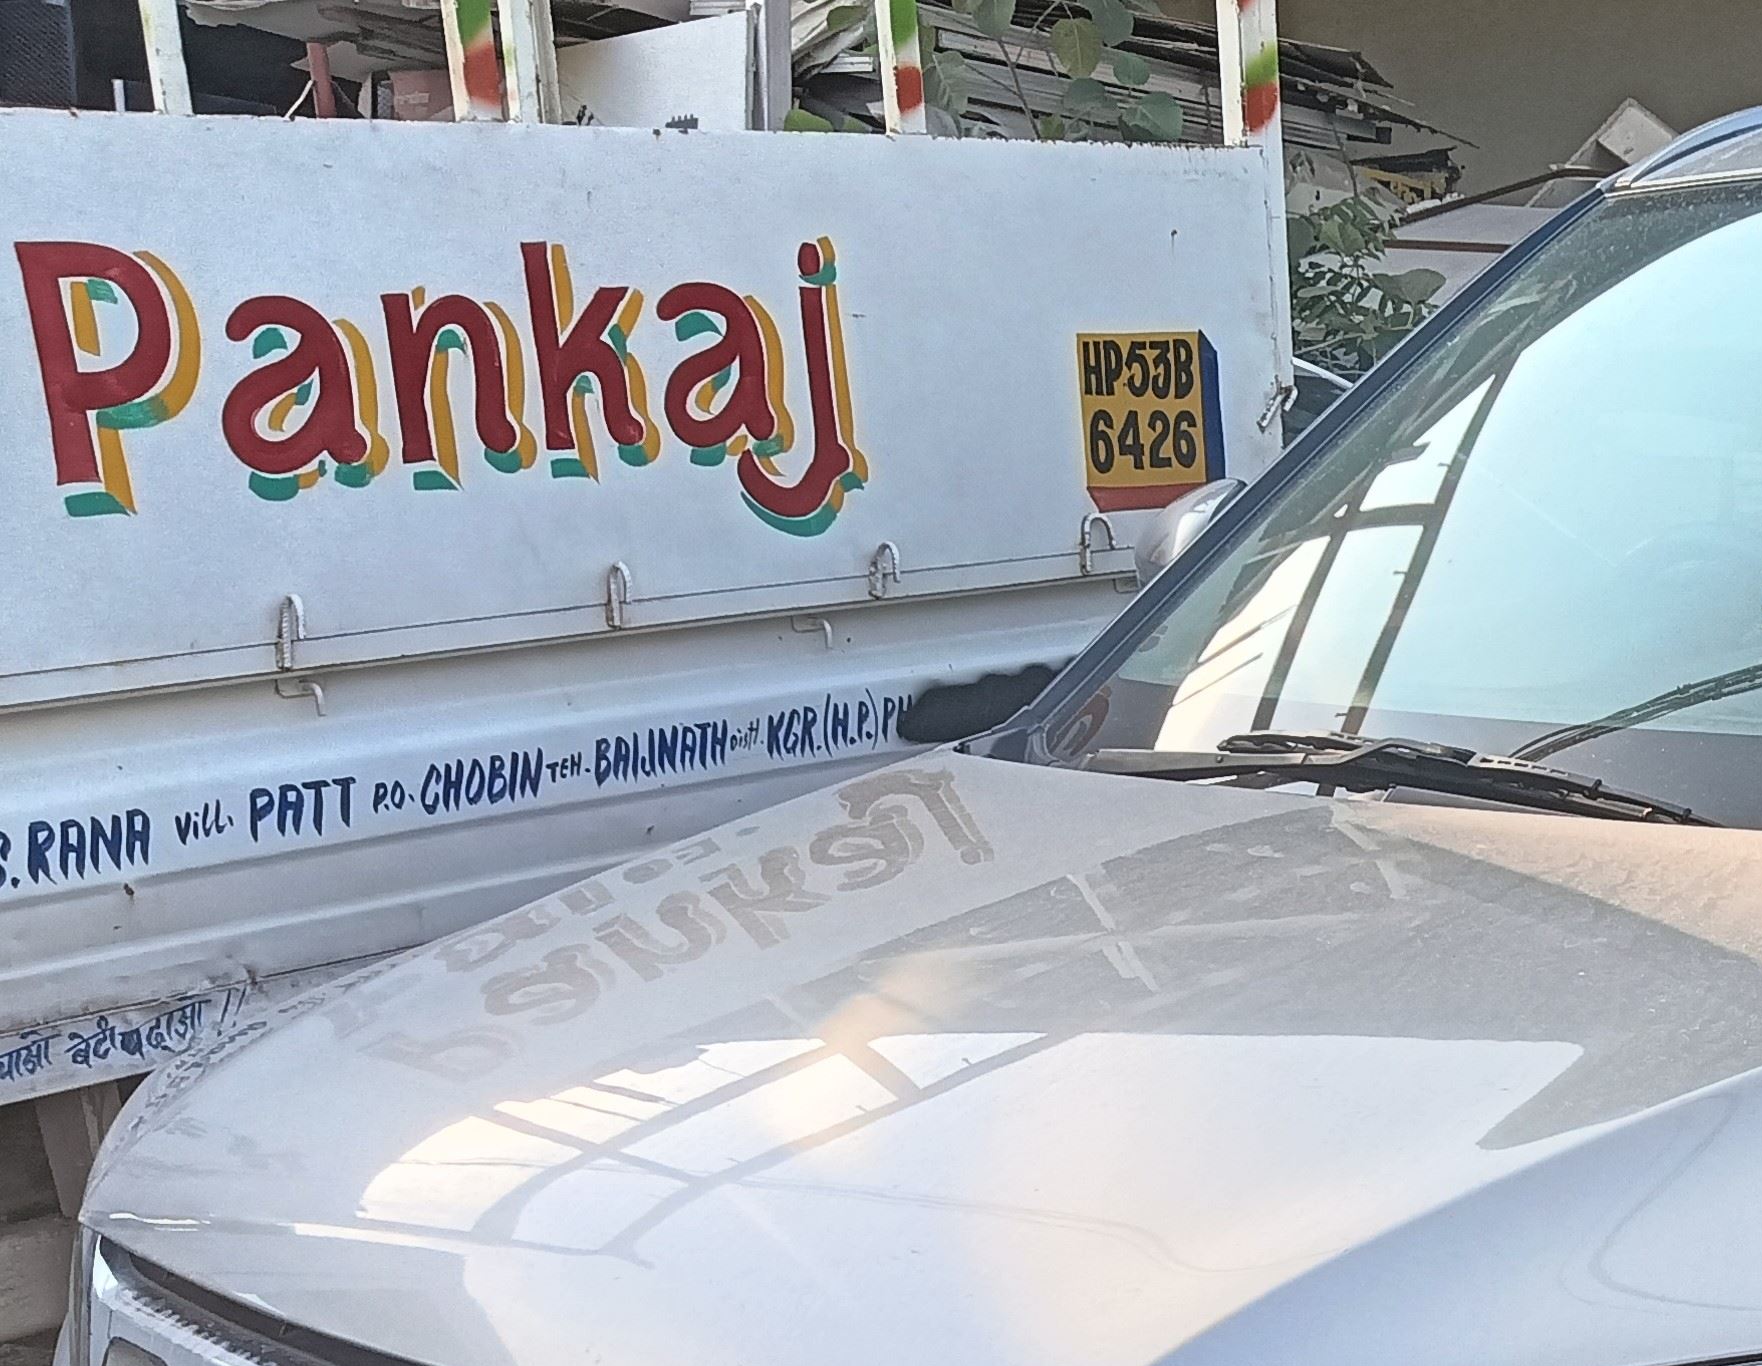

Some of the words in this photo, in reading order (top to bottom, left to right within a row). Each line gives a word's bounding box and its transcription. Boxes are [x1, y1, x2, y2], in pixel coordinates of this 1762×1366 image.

[14, 236, 869, 537] Pankaj
[1089, 409, 1197, 474] 6426
[249, 777, 356, 843] PATT
[420, 747, 543, 815] CHOBIN
[594, 718, 728, 788] BAIJNATH
